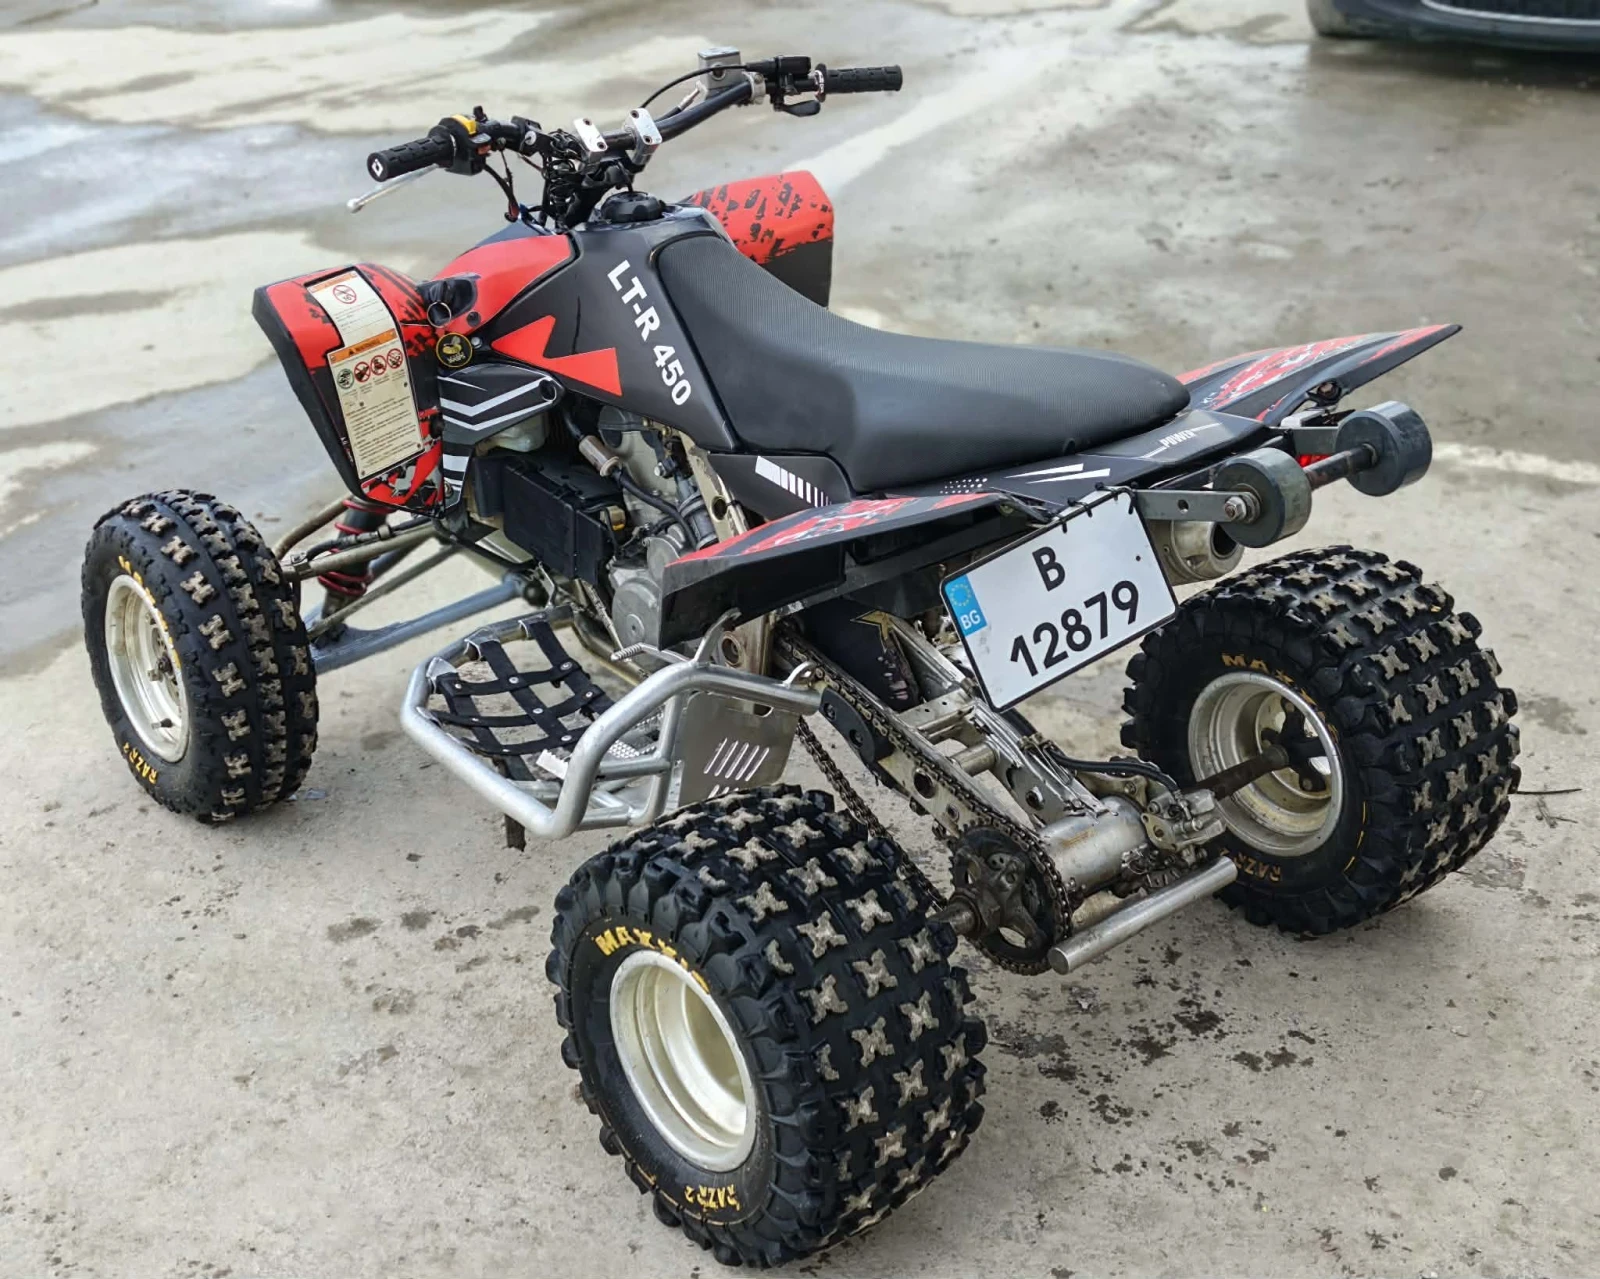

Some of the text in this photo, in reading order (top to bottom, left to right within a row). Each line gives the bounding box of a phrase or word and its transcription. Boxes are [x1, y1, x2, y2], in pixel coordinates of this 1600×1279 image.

[607, 259, 692, 406] LT-R 450
[1032, 546, 1066, 592] B
[960, 609, 981, 631] BG
[1010, 580, 1139, 677] 12879
